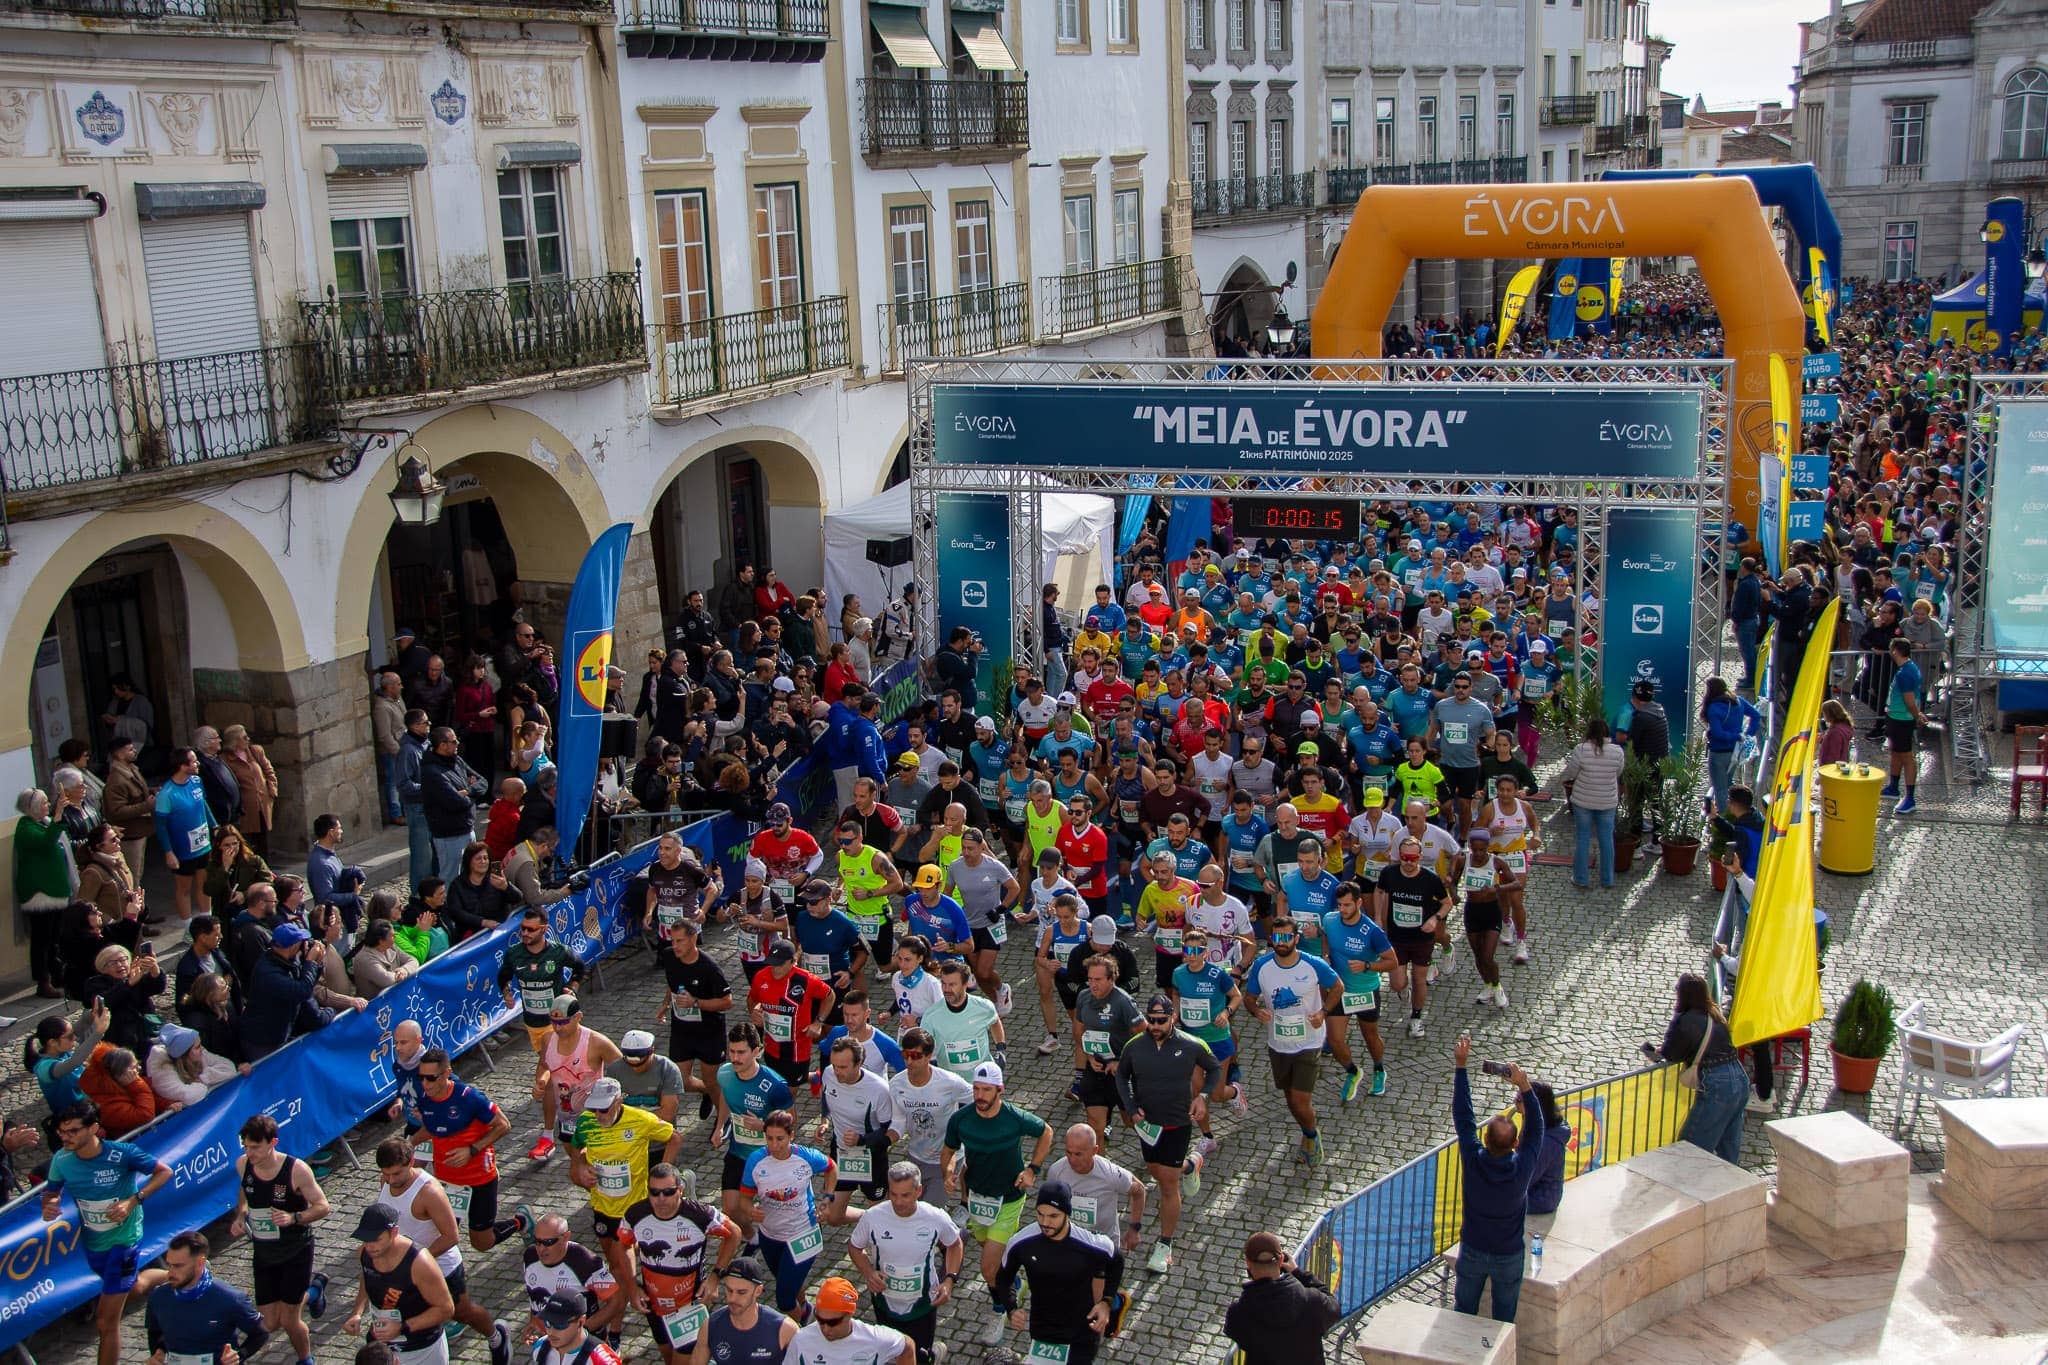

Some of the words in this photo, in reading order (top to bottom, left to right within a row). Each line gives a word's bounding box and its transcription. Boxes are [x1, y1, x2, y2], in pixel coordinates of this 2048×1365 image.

[1464, 193, 1625, 236] ÉVORA
[1526, 241, 1569, 250] Câmara
[1571, 240, 1625, 250] Municipal
[1807, 358, 1824, 367] SUB
[954, 411, 1017, 433] ÉVORA
[1267, 430, 1290, 446] DE
[1599, 419, 1673, 442] ÉVORA
[1264, 449, 1327, 461] PATRIMÓNIO
[1328, 451, 1353, 461] 2025
[1791, 460, 1807, 471] UB
[0, 1278, 55, 1323] esporto
